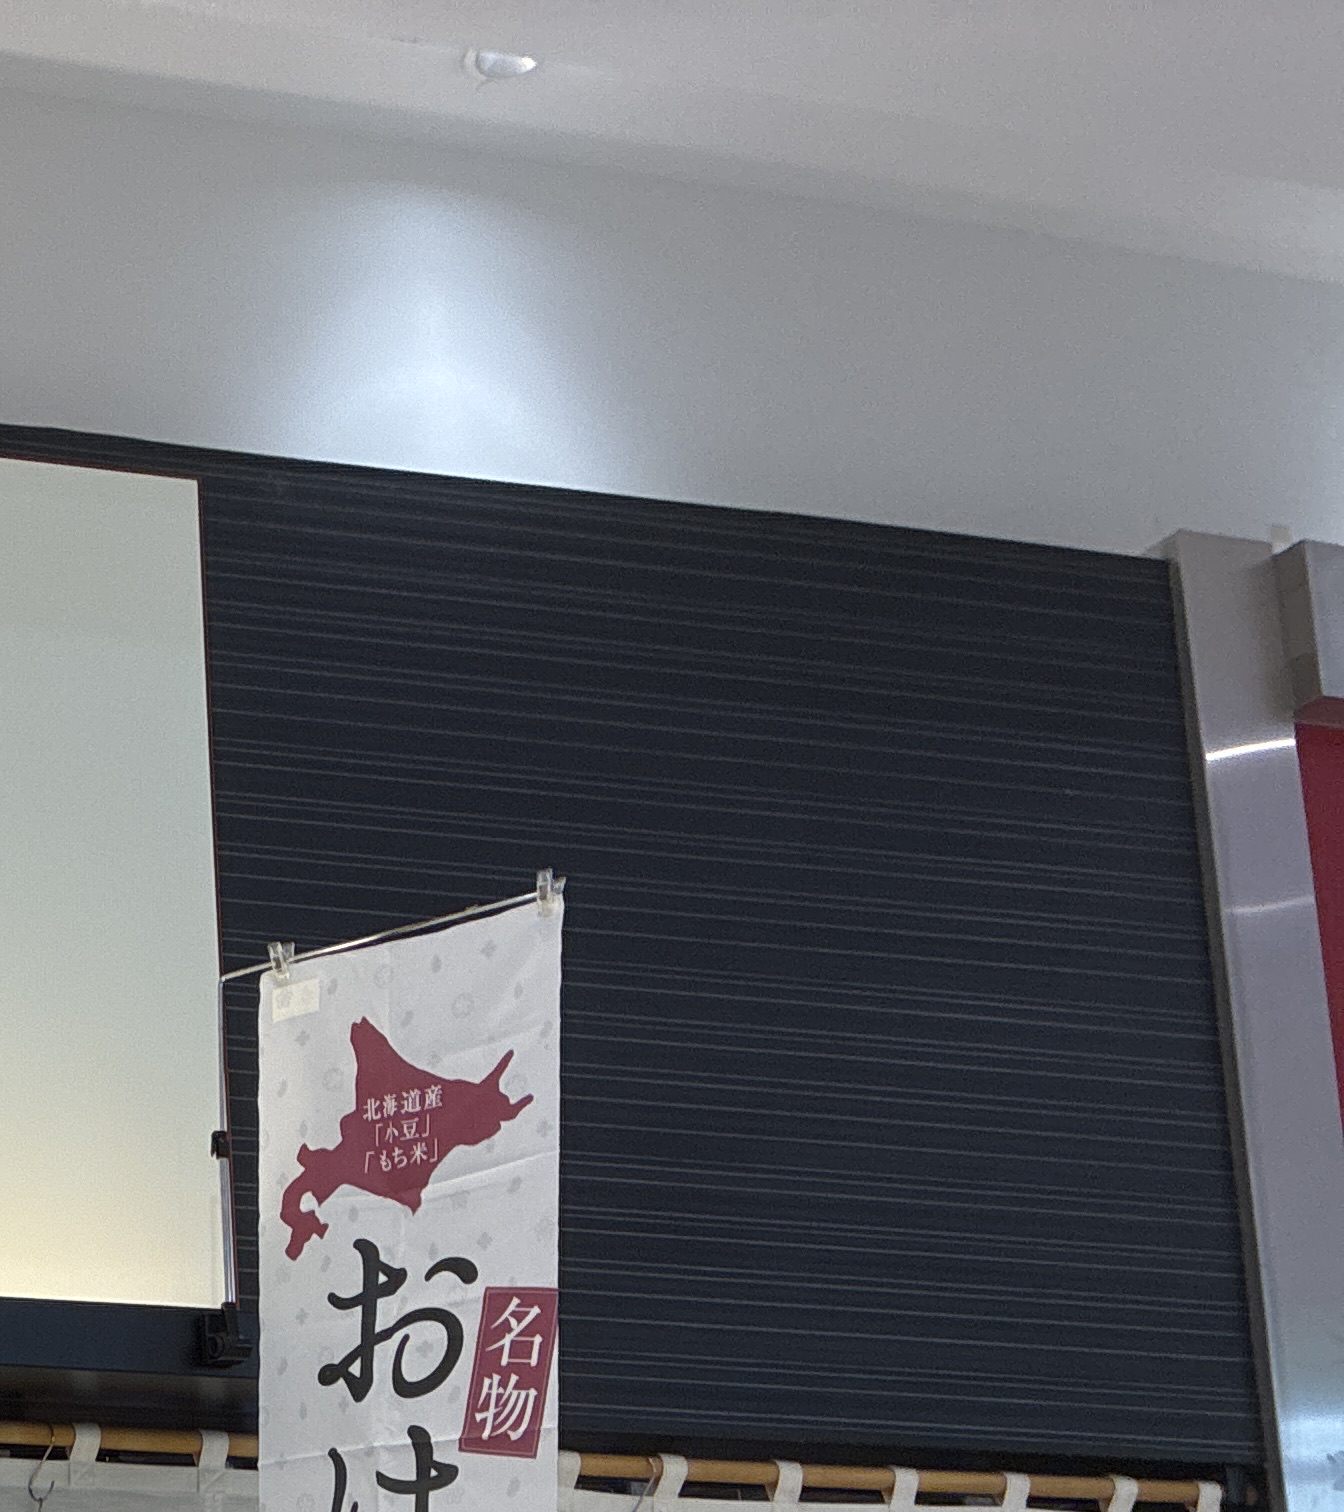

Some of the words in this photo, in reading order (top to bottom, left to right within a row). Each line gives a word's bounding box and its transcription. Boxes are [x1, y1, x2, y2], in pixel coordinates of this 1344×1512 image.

[362, 1085, 443, 1121] 北海道産
[375, 1114, 431, 1142] 「小豆」
[363, 1141, 439, 1174] 「もち米」
[475, 1296, 543, 1443] 名物
